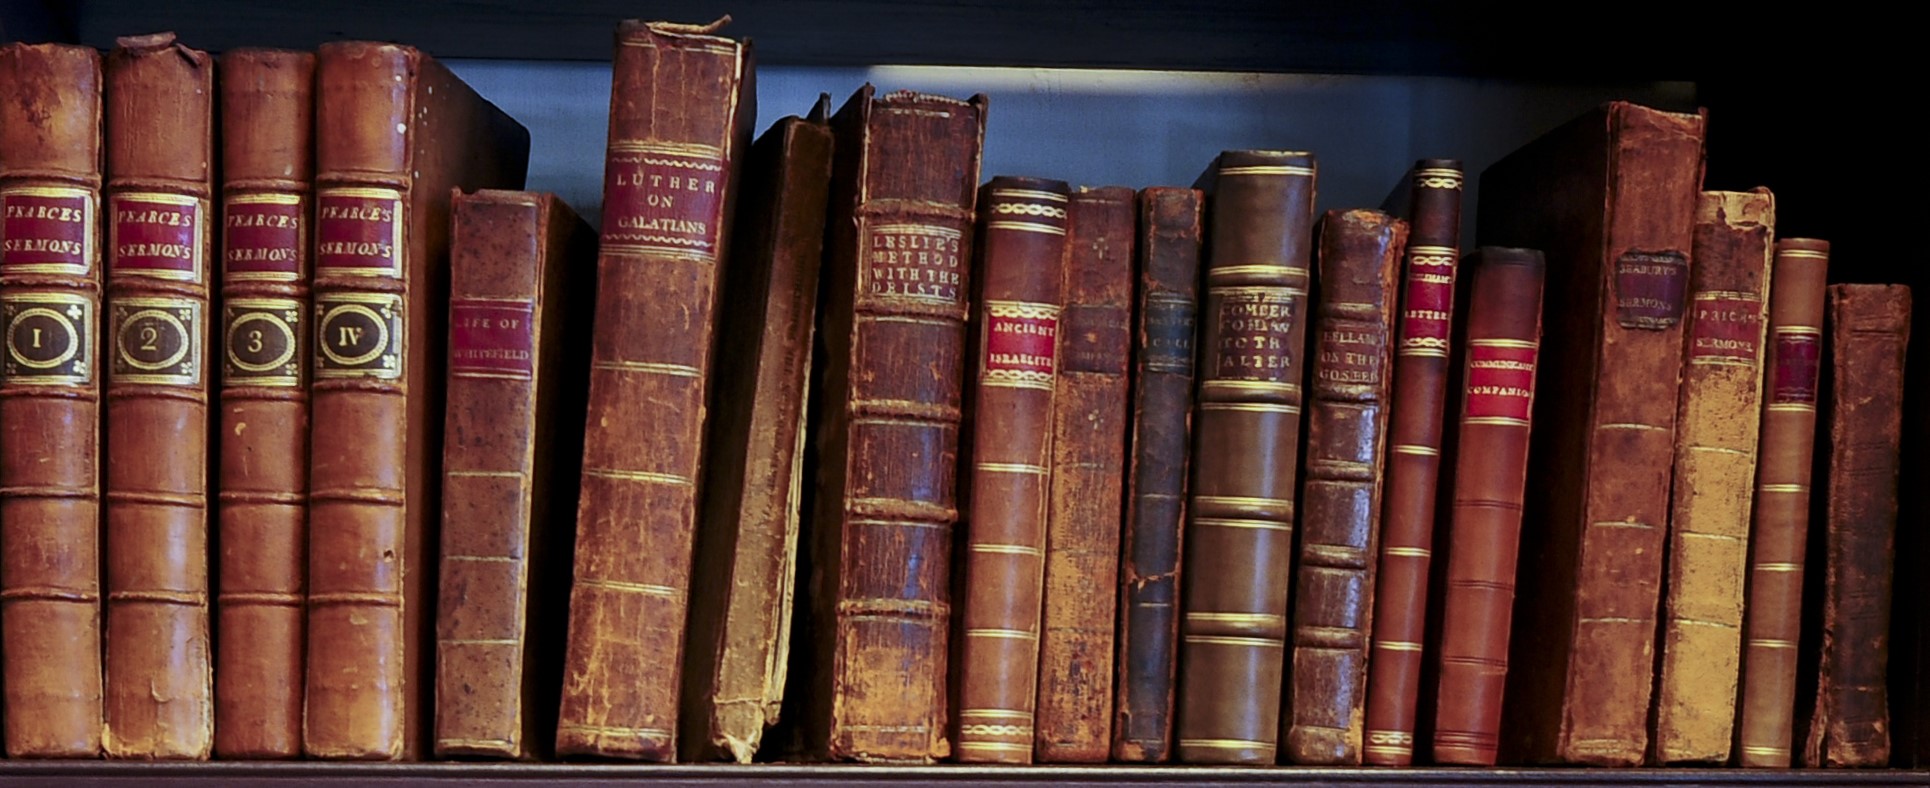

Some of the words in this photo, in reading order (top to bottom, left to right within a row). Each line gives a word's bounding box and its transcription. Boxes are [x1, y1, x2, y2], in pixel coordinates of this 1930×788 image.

[617, 173, 715, 194] LUTHER
[647, 194, 674, 208] ON
[618, 216, 706, 235] GALATIANS
[4, 239, 82, 255] SERMONS
[118, 243, 192, 259] SERMONS
[228, 247, 298, 262] SERMONS
[873, 251, 958, 267] METHOD
[873, 267, 920, 281] WITH
[926, 269, 959, 285] THE
[872, 281, 956, 298] DEISTS
[500, 318, 520, 329] OF
[994, 322, 1055, 337] ANCIENT
[33, 329, 42, 349] I
[140, 327, 158, 352] 2
[247, 330, 263, 353] 3
[338, 327, 361, 347] IV
